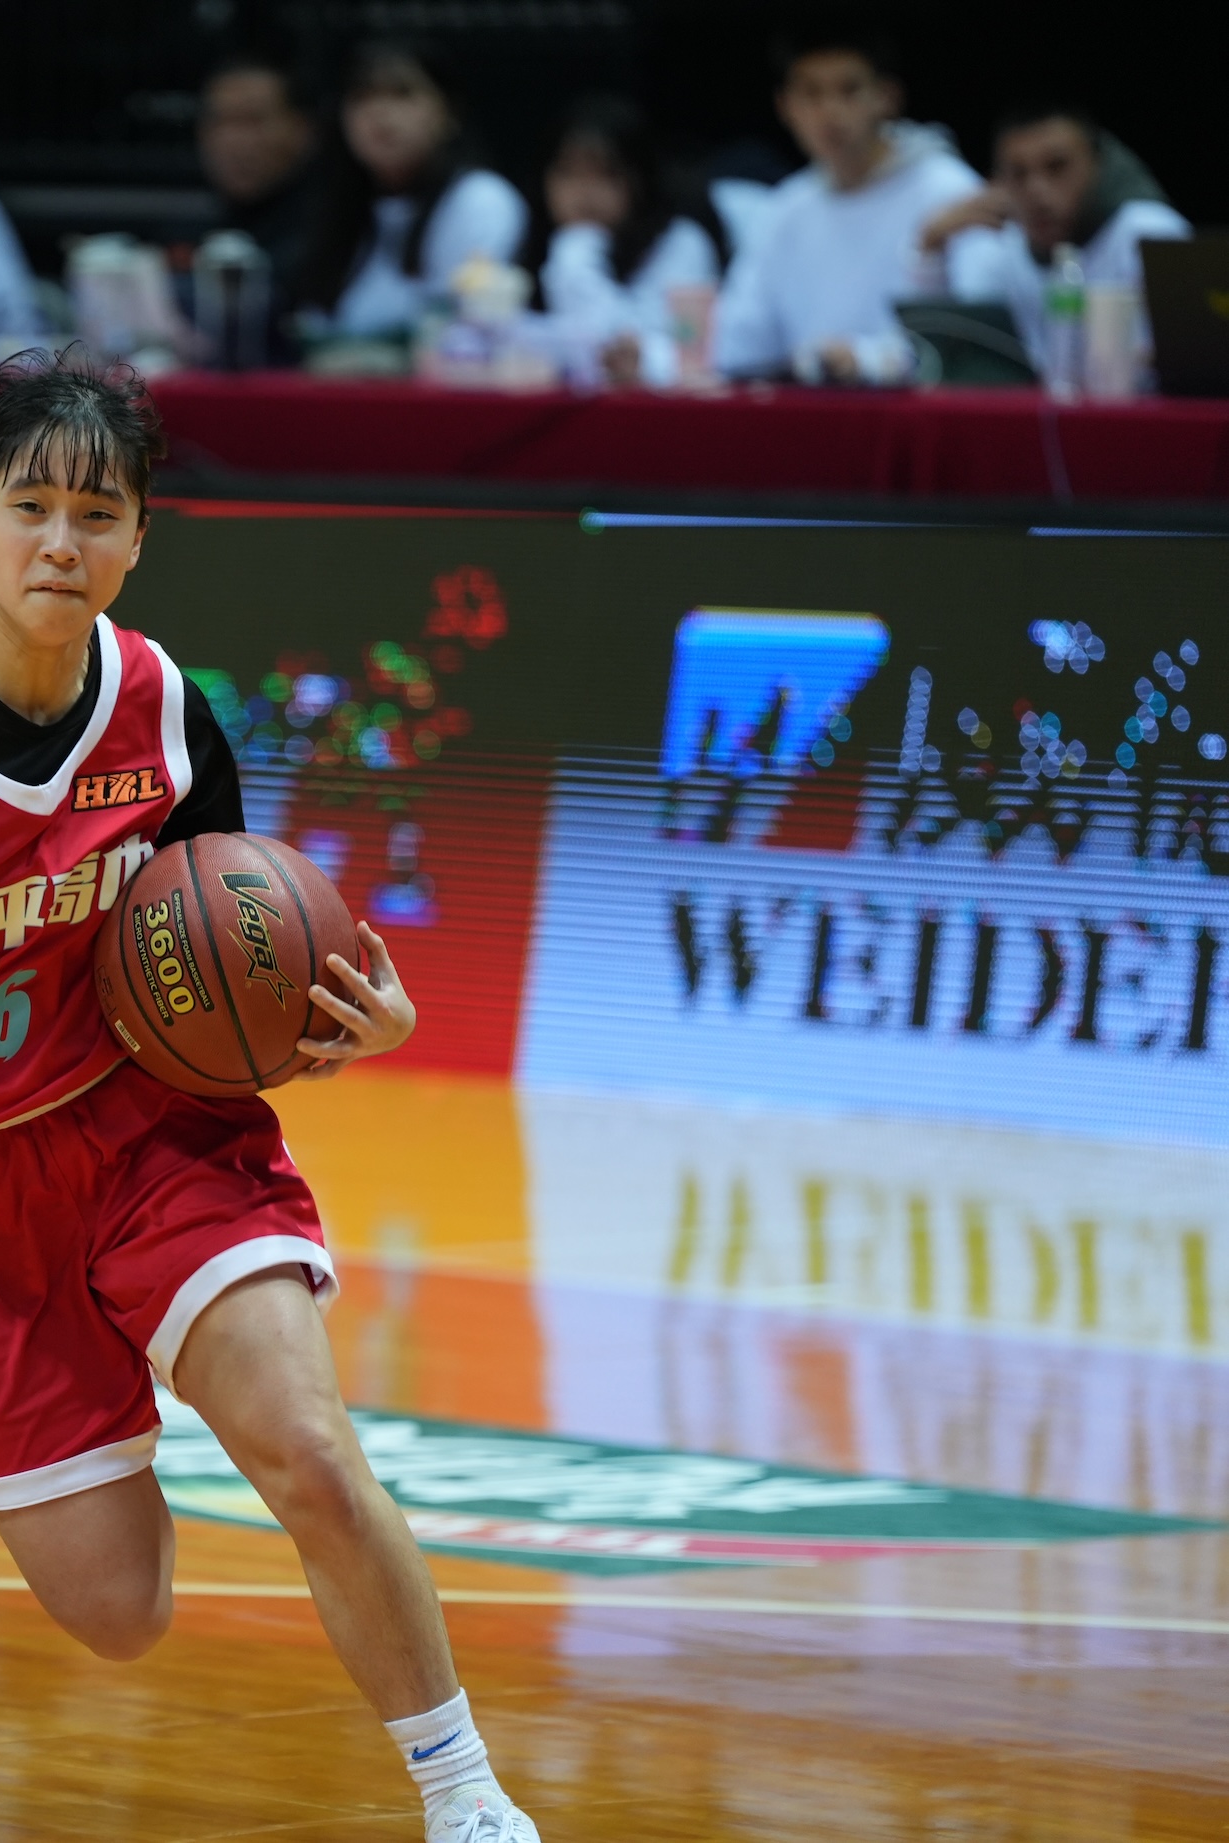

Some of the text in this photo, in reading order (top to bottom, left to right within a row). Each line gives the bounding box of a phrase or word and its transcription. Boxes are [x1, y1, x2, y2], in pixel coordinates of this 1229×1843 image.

[74, 769, 164, 810] HBL
[134, 912, 170, 1019] MICRO SYNTHETIC FIBER
[145, 901, 195, 1014] 3600
[173, 893, 211, 1008] OFFICIAL SIZE FOAM BASKETBALL
[219, 871, 284, 972] Vega
